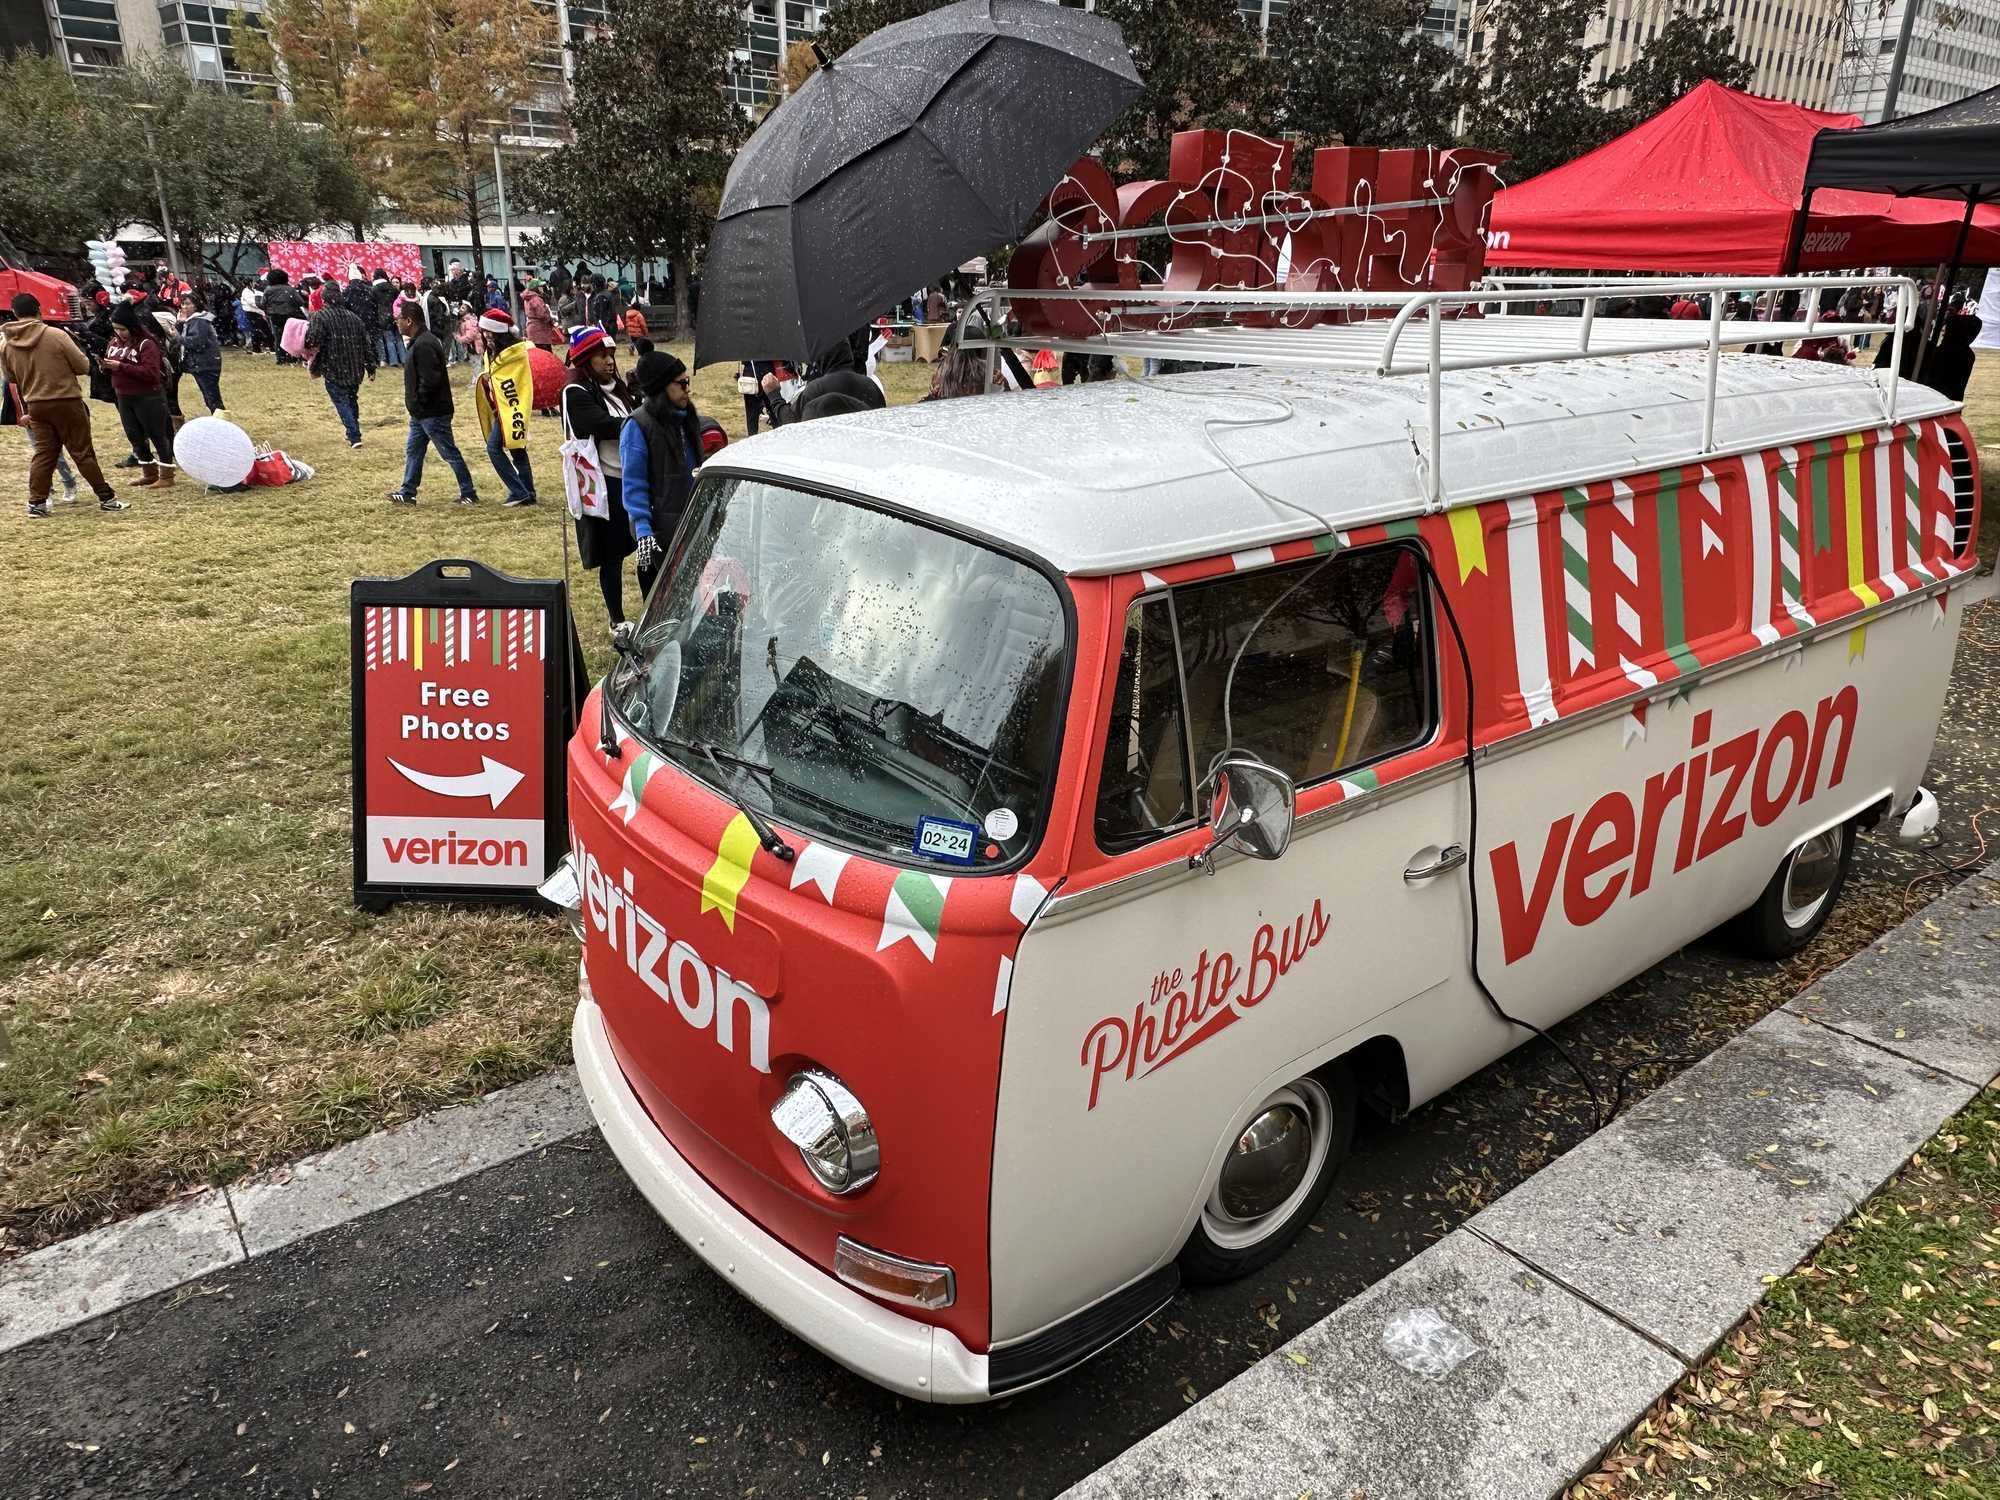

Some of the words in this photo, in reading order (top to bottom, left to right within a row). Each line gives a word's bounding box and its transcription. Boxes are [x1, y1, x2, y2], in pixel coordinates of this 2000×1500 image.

[421, 682, 490, 706] Free
[401, 715, 510, 741] Photos
[1489, 685, 1859, 966] verizon
[383, 831, 528, 867] verizon
[570, 820, 771, 1074] verizon
[1081, 949, 1241, 1112] Photo
[1236, 897, 1331, 1008] Bus
[1150, 967, 1183, 1005] the
